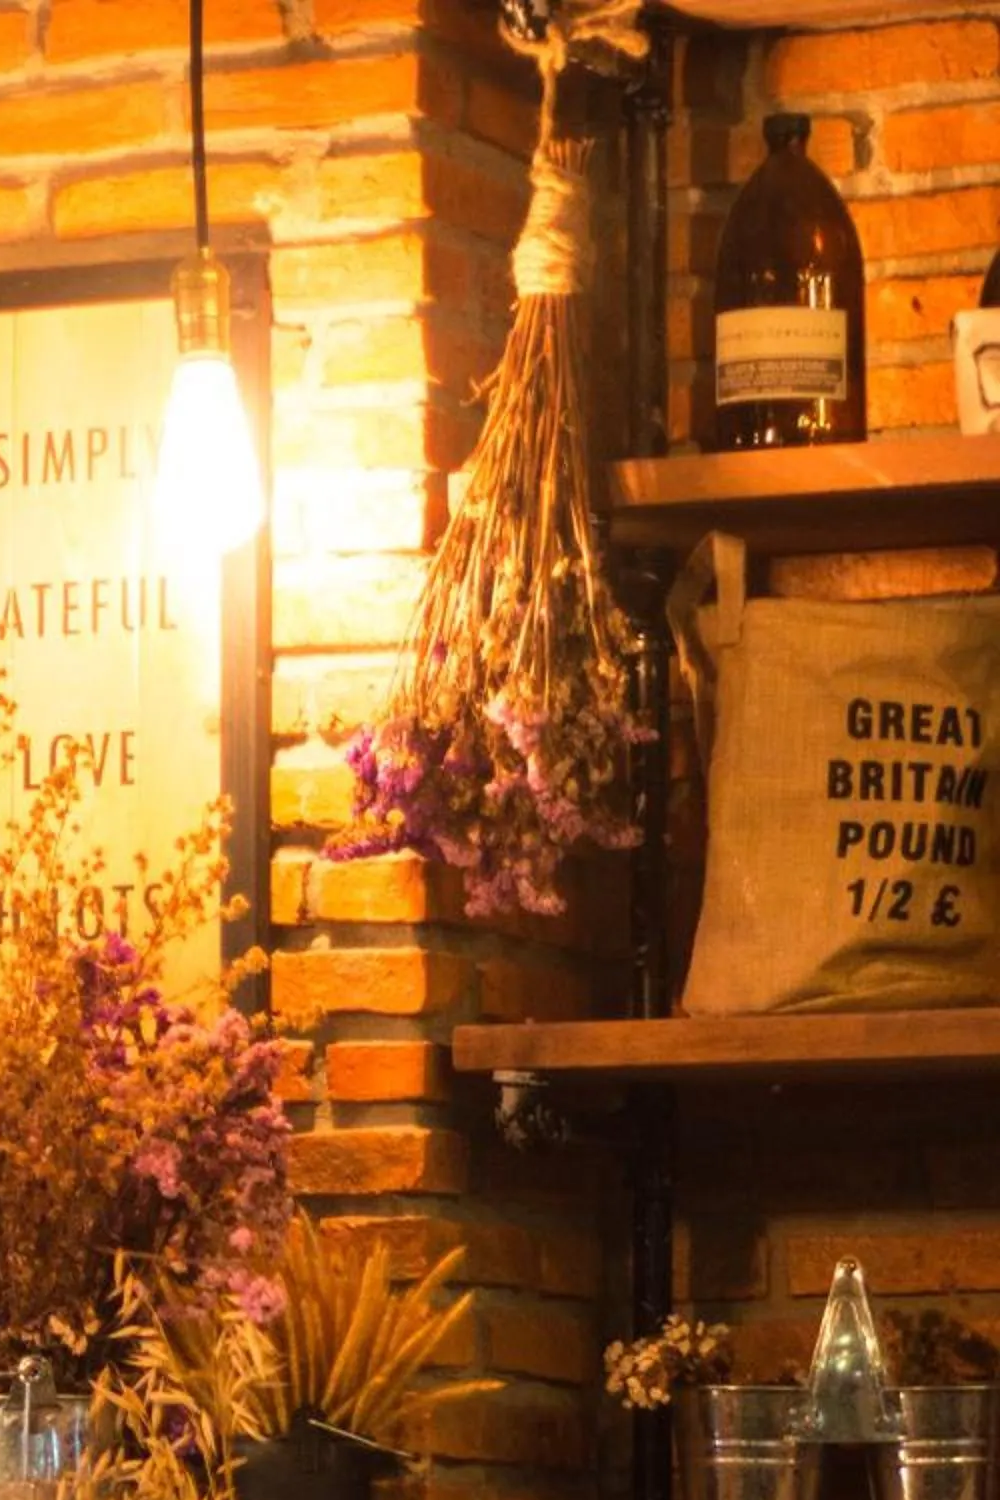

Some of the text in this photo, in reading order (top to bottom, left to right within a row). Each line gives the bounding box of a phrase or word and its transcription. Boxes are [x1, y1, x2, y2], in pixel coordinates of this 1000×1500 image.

[23, 731, 136, 792] LOVE
[827, 760, 989, 810] BRITAIN
[836, 821, 977, 867] POUND
[846, 878, 963, 927] 1/2 £
